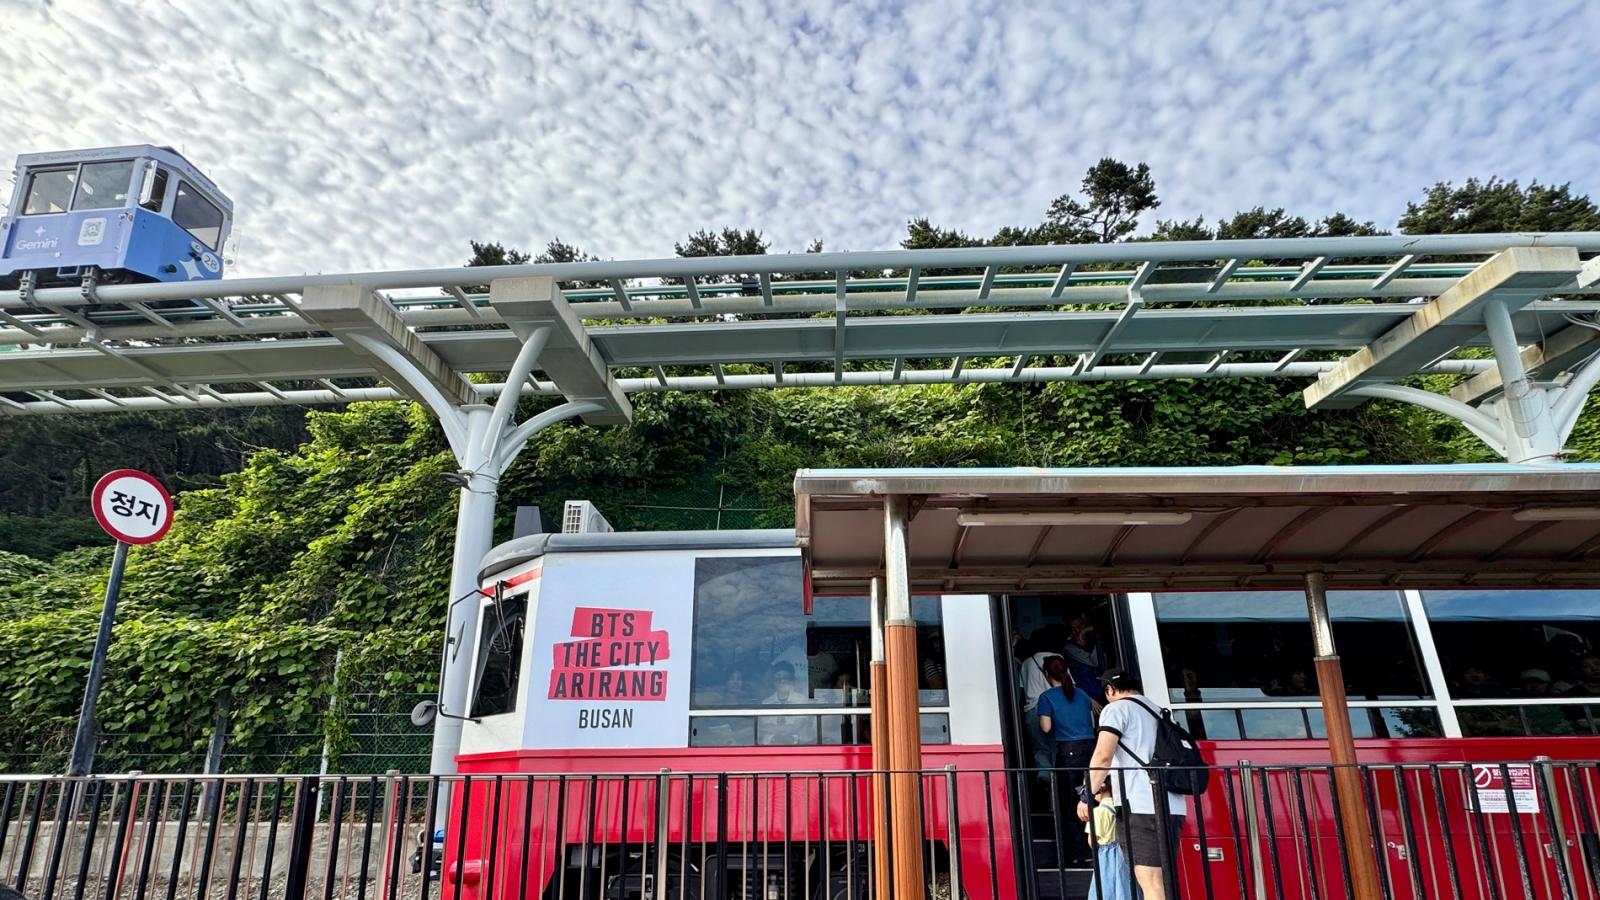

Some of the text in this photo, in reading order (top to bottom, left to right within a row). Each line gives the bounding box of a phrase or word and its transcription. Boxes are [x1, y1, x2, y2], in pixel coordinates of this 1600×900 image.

[16, 237, 58, 250] Gemini
[203, 254, 218, 270] 28
[110, 490, 160, 526] 정지
[590, 612, 635, 637] BTS
[563, 641, 660, 668] THE CITY
[553, 671, 663, 698] ARIRANG
[578, 708, 633, 729] BUSAN
